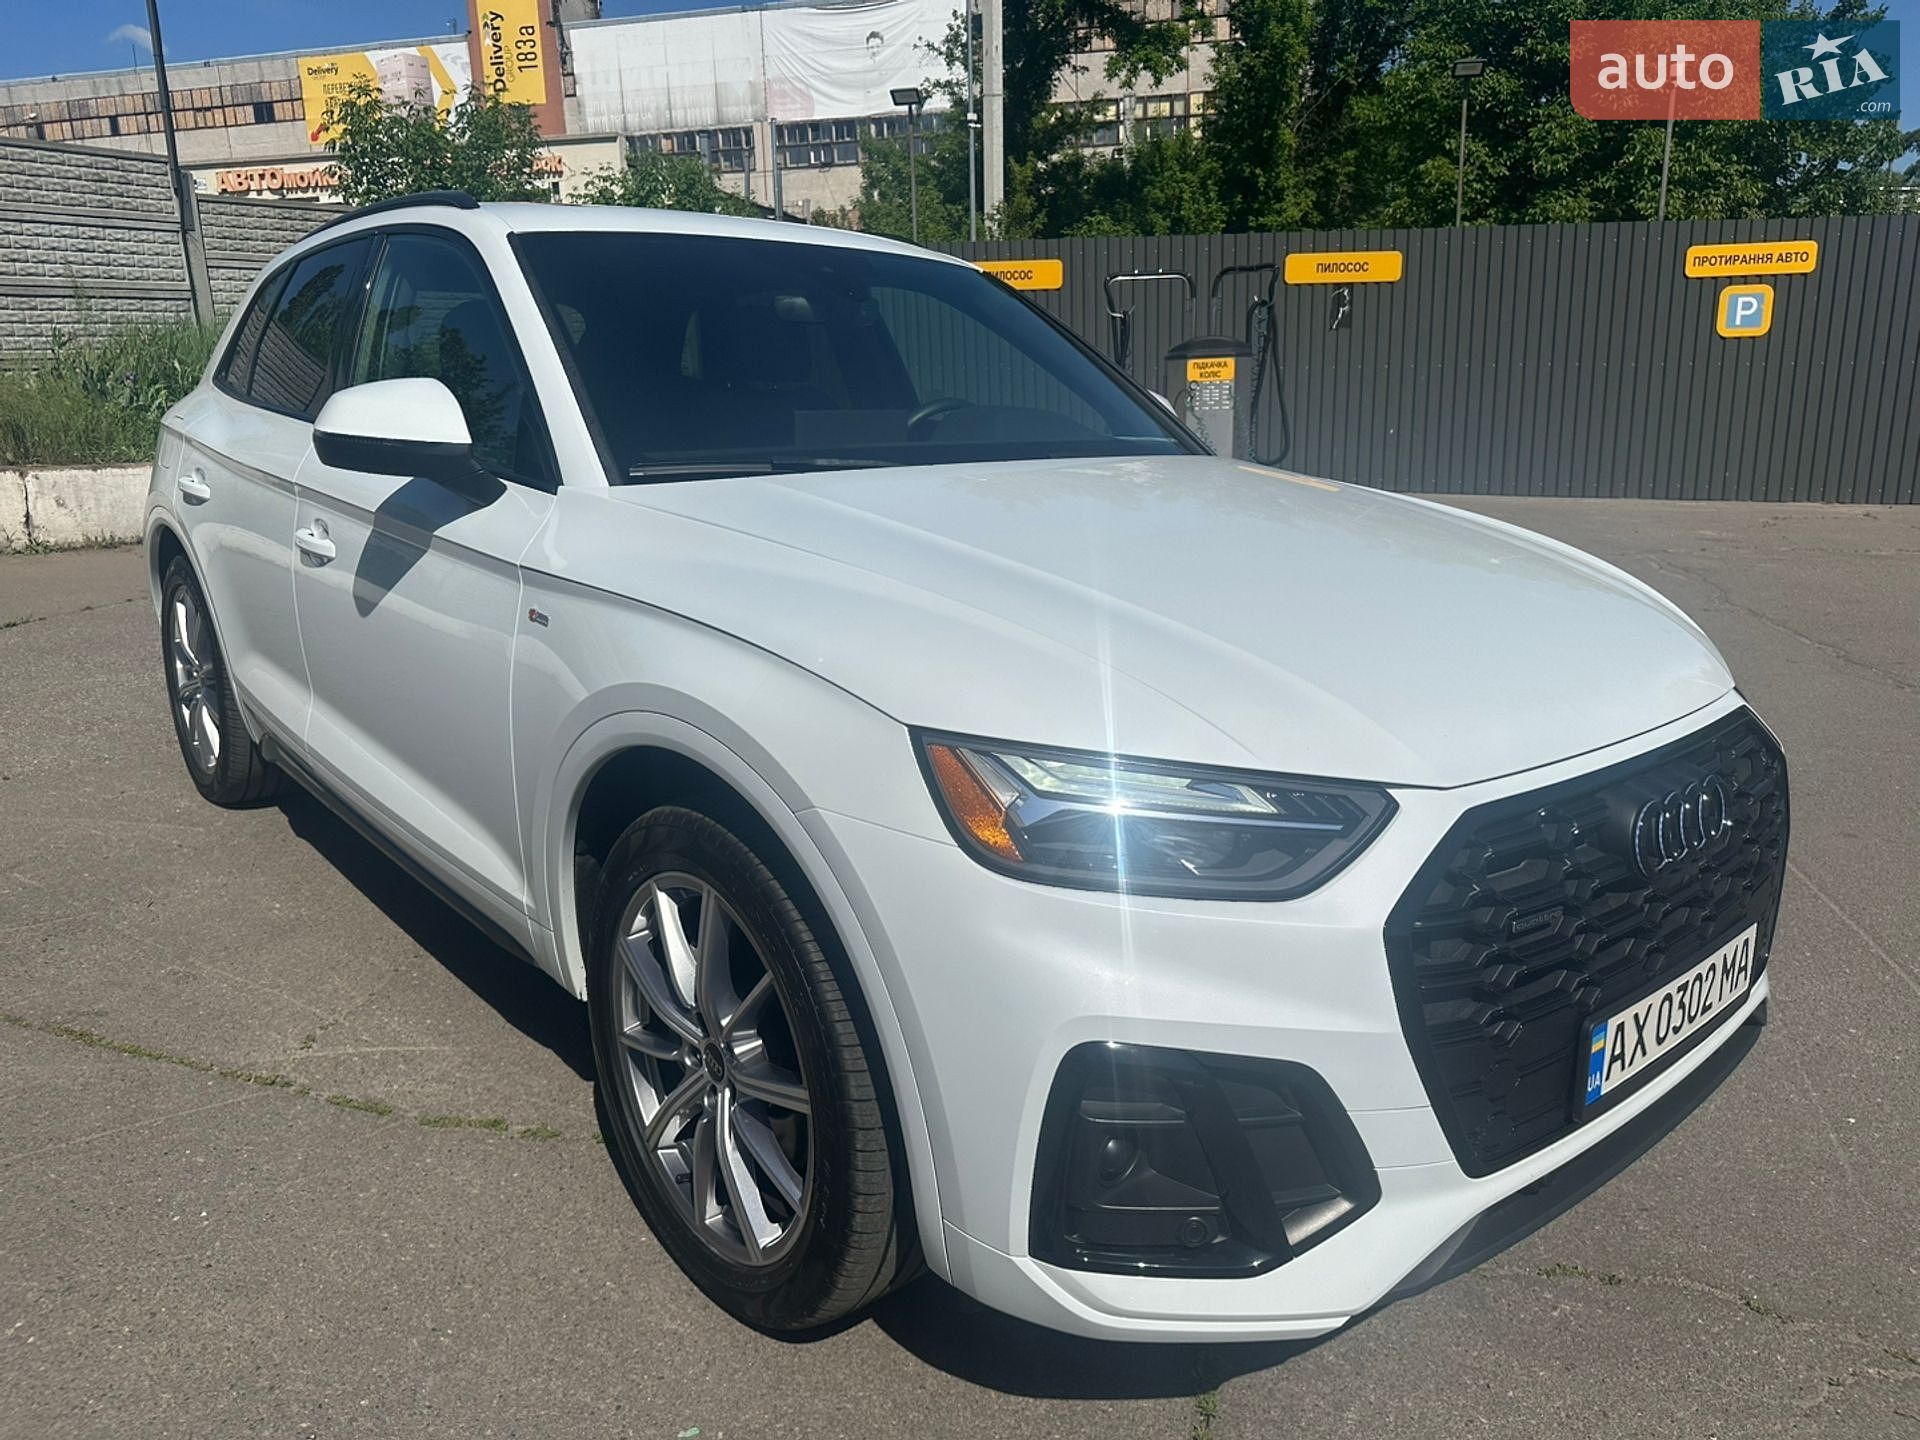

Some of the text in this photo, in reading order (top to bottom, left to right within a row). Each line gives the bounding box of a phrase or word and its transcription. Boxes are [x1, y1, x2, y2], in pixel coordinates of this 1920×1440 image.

[488, 10, 507, 92] Delivery
[307, 65, 339, 76] Delivery
[1316, 261, 1369, 273] ПИЛОСОС
[1693, 251, 1809, 267] ПРОТИРАННЯ АВТО
[986, 270, 1033, 281] ЛОСОС
[1735, 296, 1758, 326] P
[1604, 937, 1750, 1082] AX 0302 MA
[1587, 1071, 1601, 1092] UA
